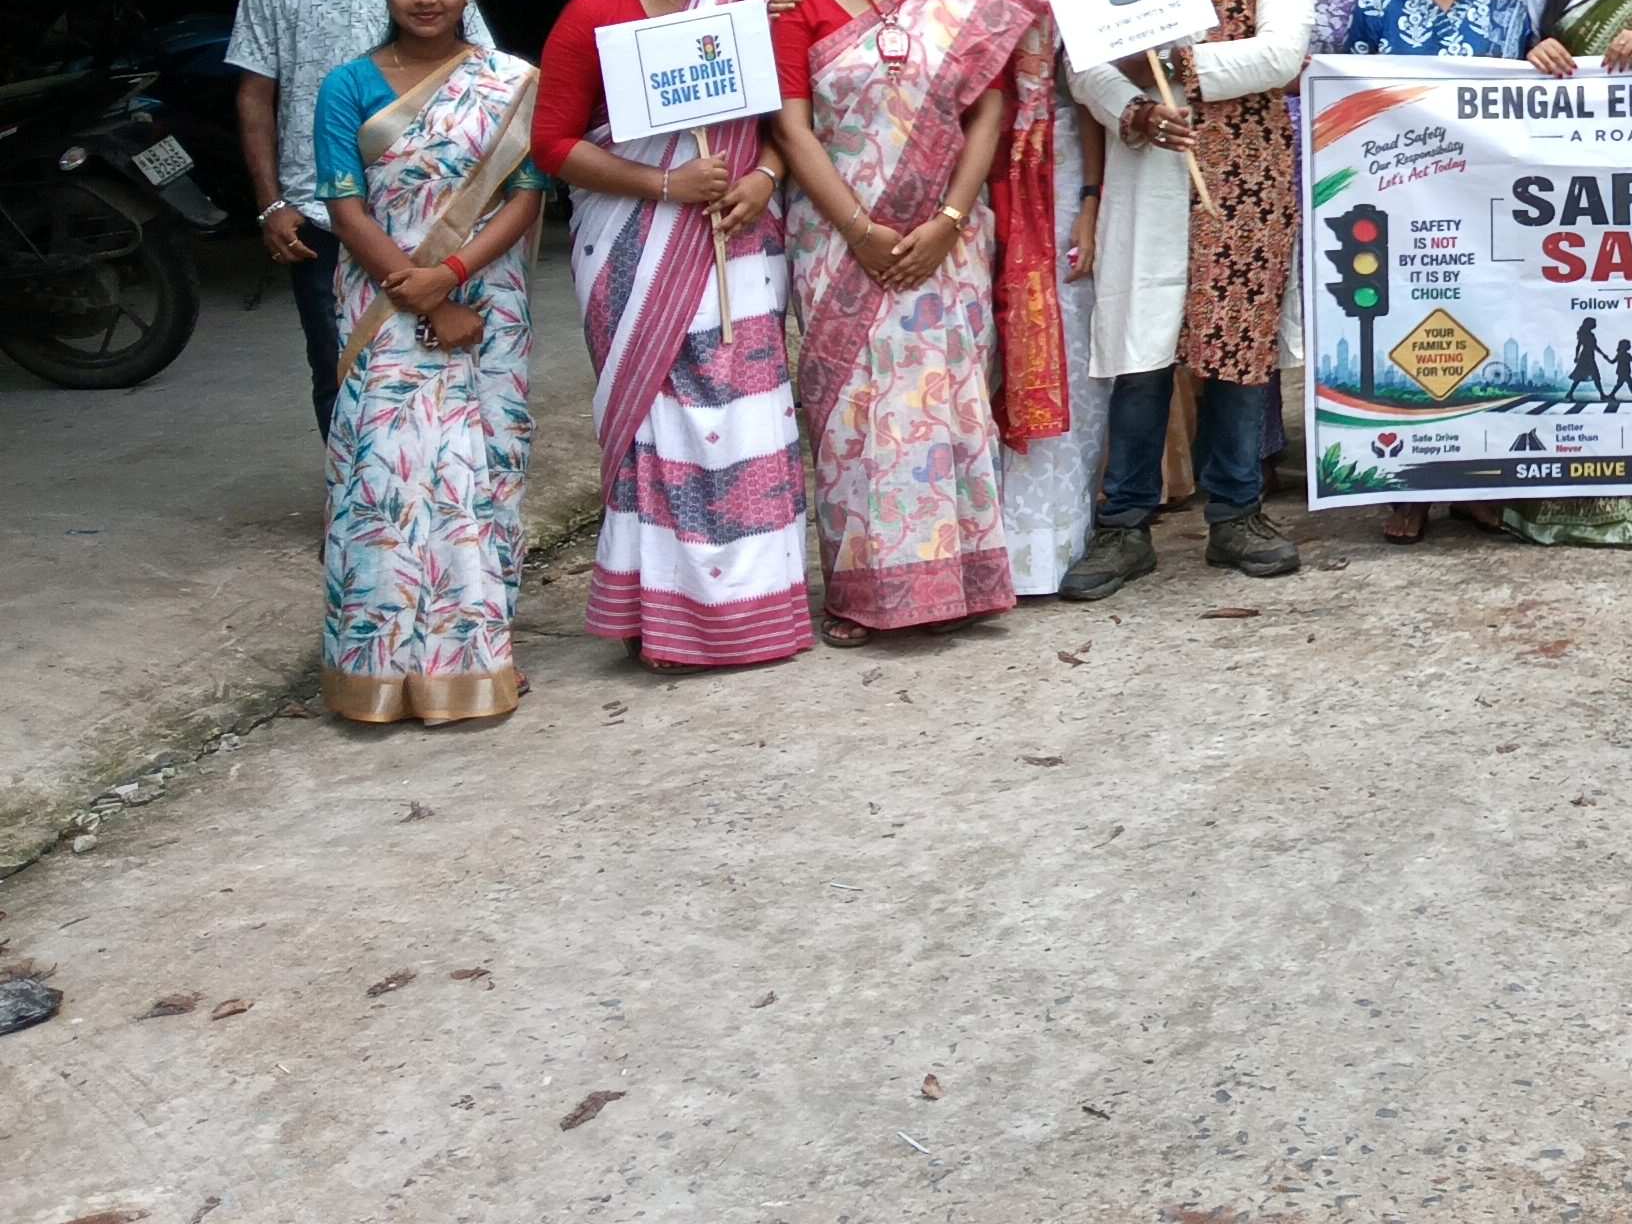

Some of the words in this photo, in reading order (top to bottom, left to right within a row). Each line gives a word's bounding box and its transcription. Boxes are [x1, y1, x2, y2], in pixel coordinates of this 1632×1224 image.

[650, 68, 686, 89] SAFE
[689, 58, 735, 82] DRIVE
[660, 84, 700, 107] SAVE
[704, 77, 737, 98] LIFE
[1457, 85, 1594, 119] BENGAL
[1362, 135, 1400, 158] Road
[1404, 125, 1447, 147] Safety
[1570, 130, 1583, 142] A
[1369, 158, 1390, 176] Our
[1394, 141, 1465, 169] Responsibility
[1378, 174, 1404, 192] Let's
[1407, 167, 1429, 183] Act
[1430, 158, 1467, 179] Today
[1410, 219, 1462, 234] SAFETY
[1413, 237, 1427, 249] IS
[1431, 236, 1458, 249] NOT
[1399, 254, 1417, 267] BY
[1422, 252, 1475, 267] CHANCE
[1410, 271, 1422, 283] IT
[1426, 271, 1438, 283] IS
[1443, 270, 1461, 283] BY
[1411, 287, 1461, 300] CHOICE
[1571, 297, 1620, 310] Follow
[1424, 327, 1455, 339] YOUR
[1412, 340, 1452, 353] FAMILY
[1455, 340, 1467, 351] IS
[1415, 352, 1464, 364] WAITING
[1416, 365, 1439, 377] FOR
[1442, 365, 1464, 377] YOU
[1555, 423, 1584, 432] Better
[1412, 433, 1432, 443] Safe
[1435, 432, 1460, 443] Drive
[1555, 433, 1573, 442] Late
[1577, 432, 1599, 442] than
[1412, 443, 1439, 455] Happy
[1442, 442, 1461, 453] Life
[1556, 444, 1582, 453] Never
[1516, 462, 1562, 478] SAFE
[1570, 460, 1626, 477] DRIVE
